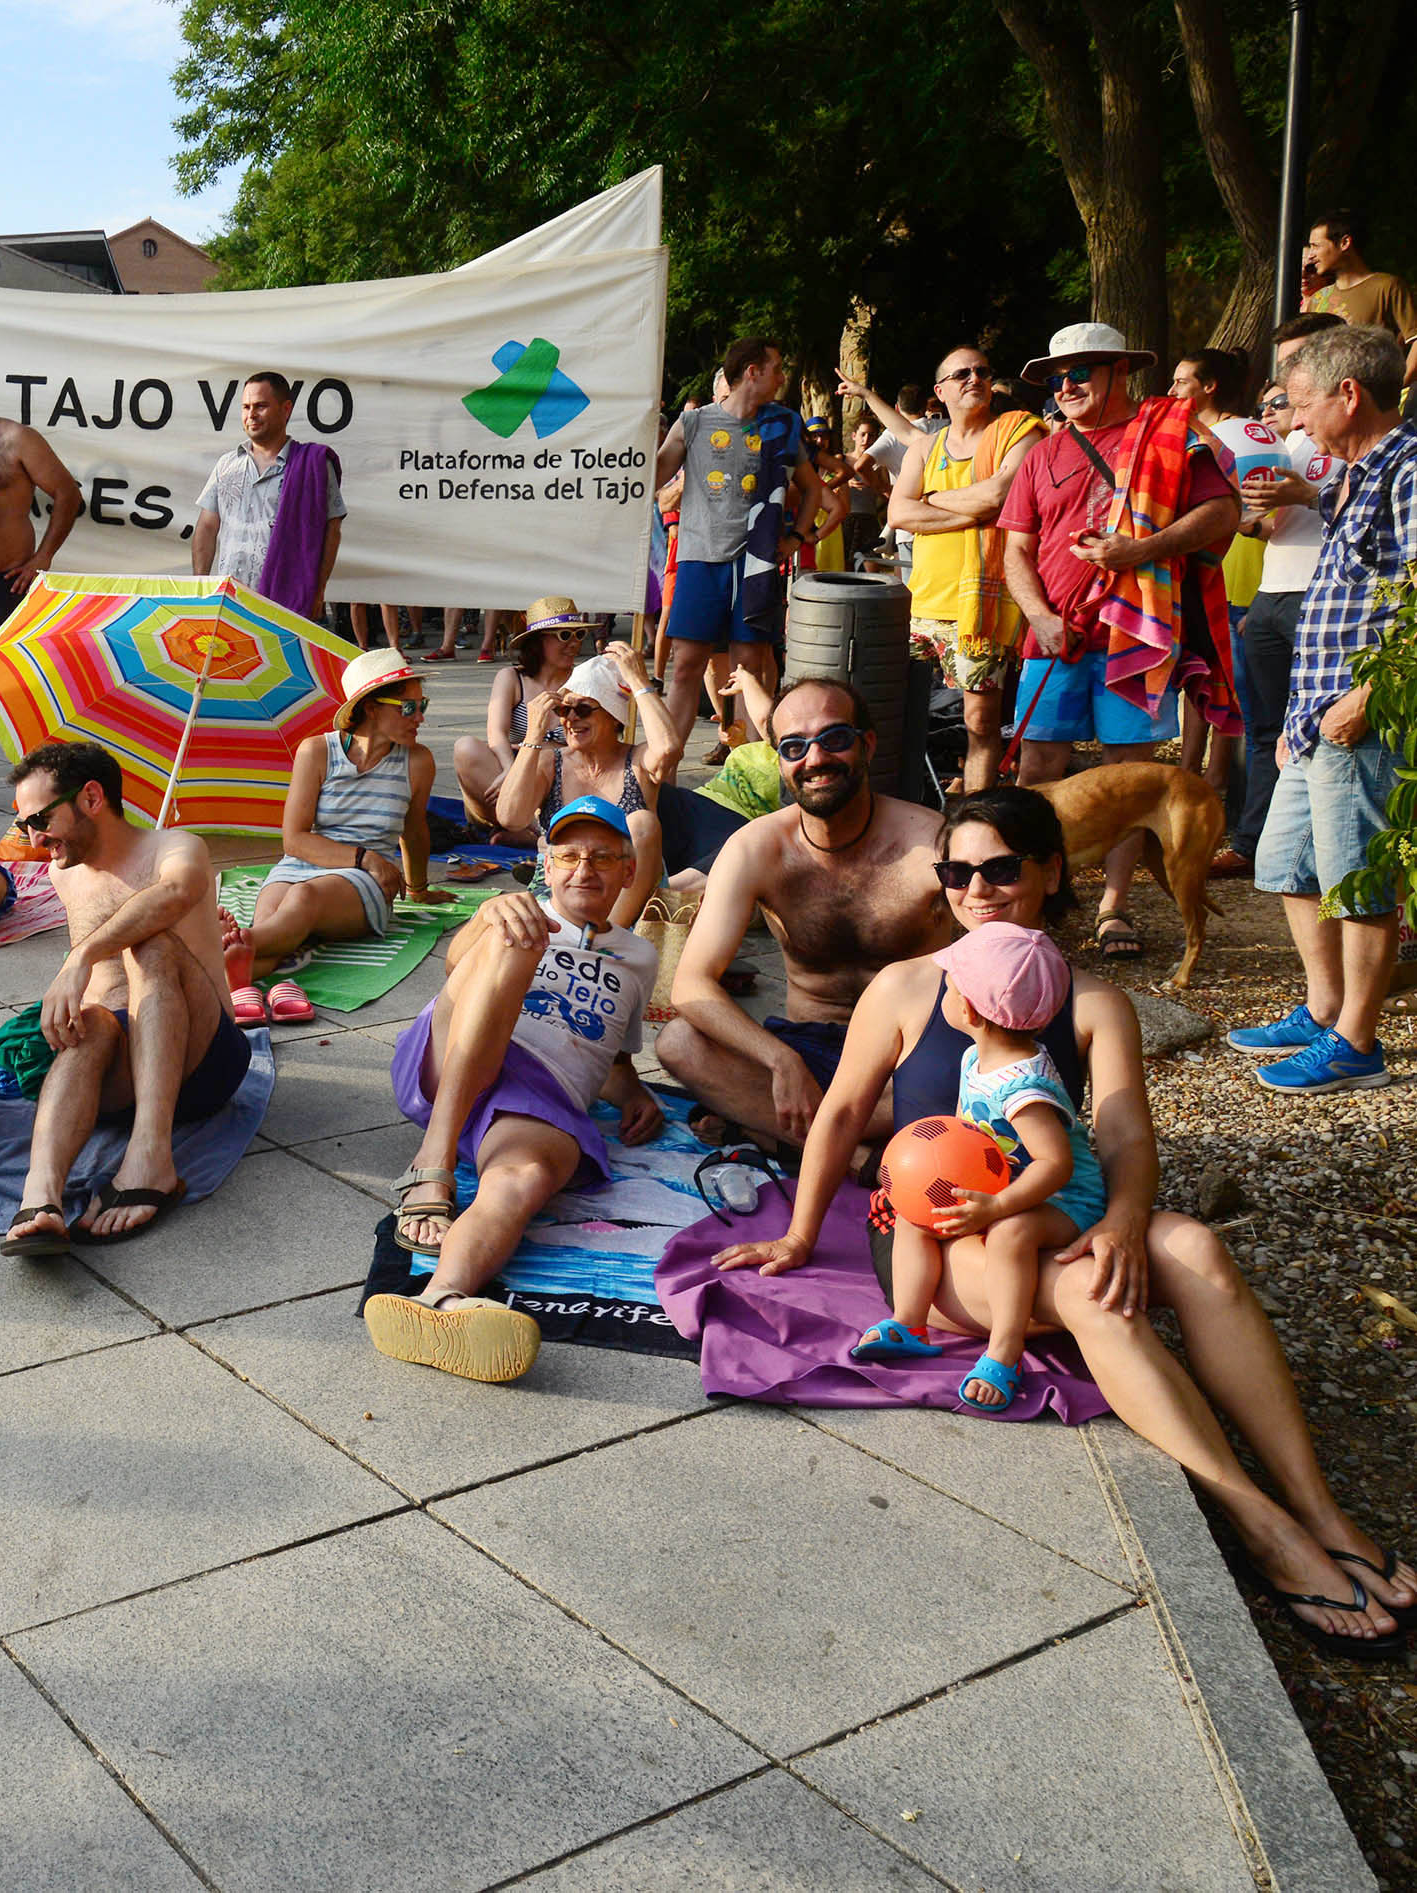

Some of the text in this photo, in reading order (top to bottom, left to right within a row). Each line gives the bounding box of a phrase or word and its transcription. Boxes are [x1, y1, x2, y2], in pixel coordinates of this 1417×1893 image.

[5, 374, 174, 431] TAJO
[198, 378, 354, 434] VO
[399, 446, 647, 471] Plataforma de Toledo
[398, 476, 645, 504] en Defensa del Tajo
[565, 972, 616, 1015] Tejo
